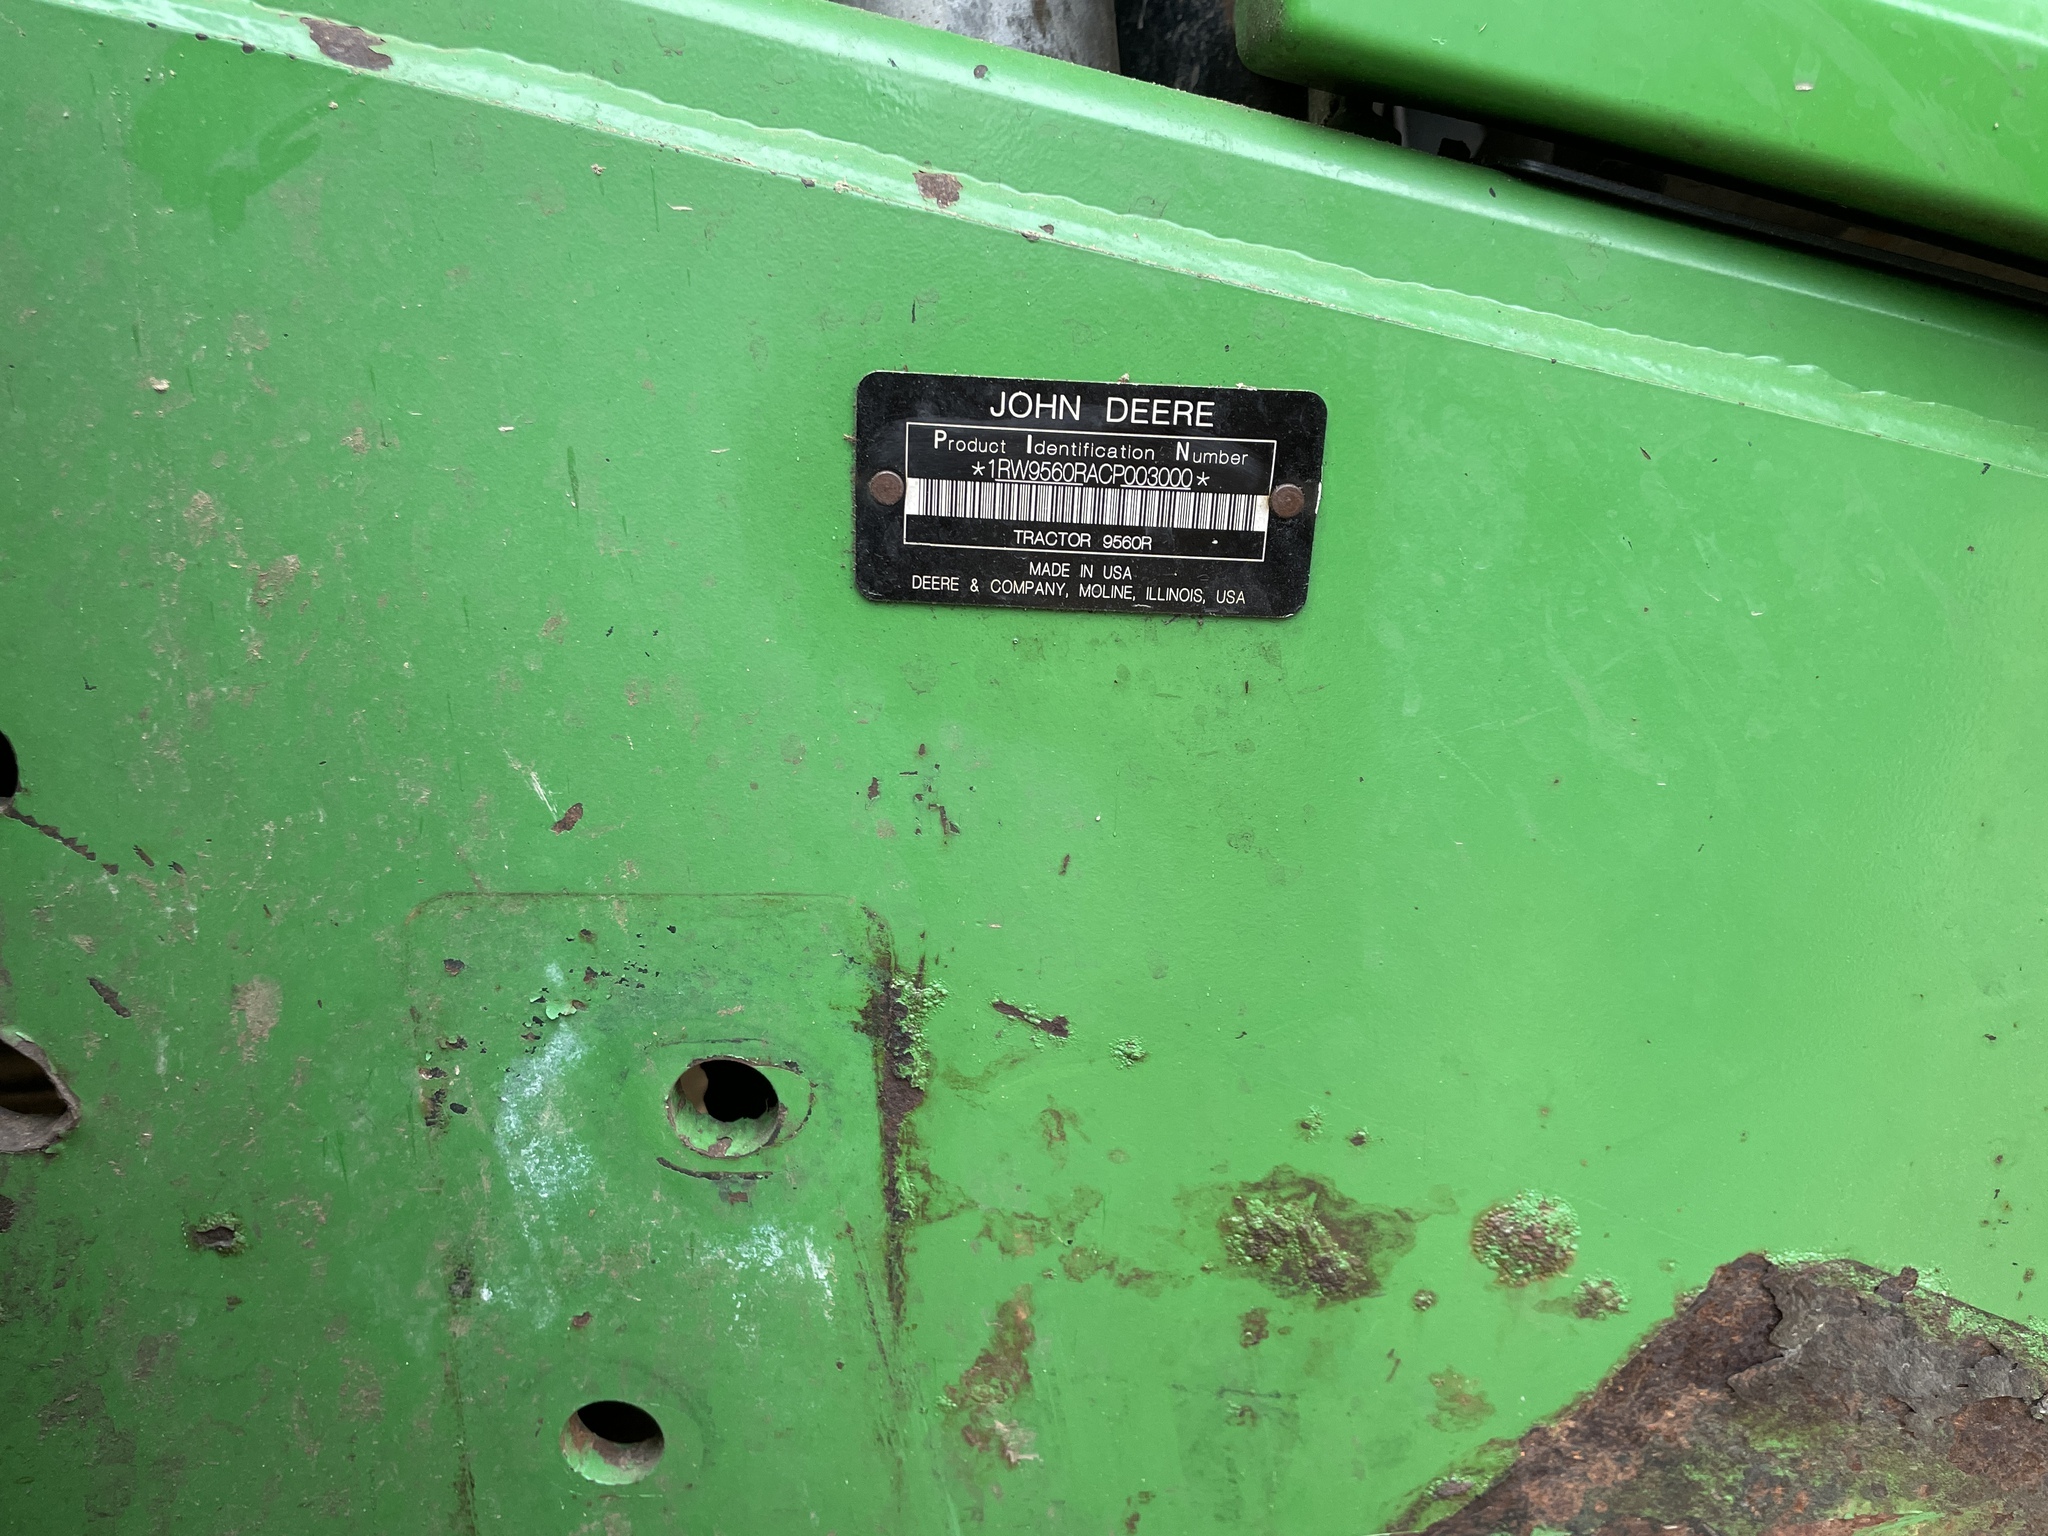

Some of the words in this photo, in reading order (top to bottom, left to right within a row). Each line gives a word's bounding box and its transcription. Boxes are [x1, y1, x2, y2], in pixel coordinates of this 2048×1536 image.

[989, 391, 1080, 421] JOHN
[1106, 398, 1215, 428] DEERE
[933, 430, 1006, 454] Product
[1027, 434, 1154, 461] Identification
[1175, 442, 1248, 465] Number
[1014, 530, 1091, 548] TRACTOR
[1103, 535, 1152, 550] 9560R
[1029, 562, 1070, 578] MADE
[1080, 565, 1093, 578] IN
[1103, 565, 1132, 580] USA
[912, 575, 959, 591] DEERE
[970, 578, 979, 592] &
[990, 578, 1069, 598] COMPANY,
[1079, 583, 1136, 601] MOLINE,
[1146, 587, 1205, 605] ILLINOIS,
[1216, 589, 1246, 604] USA
